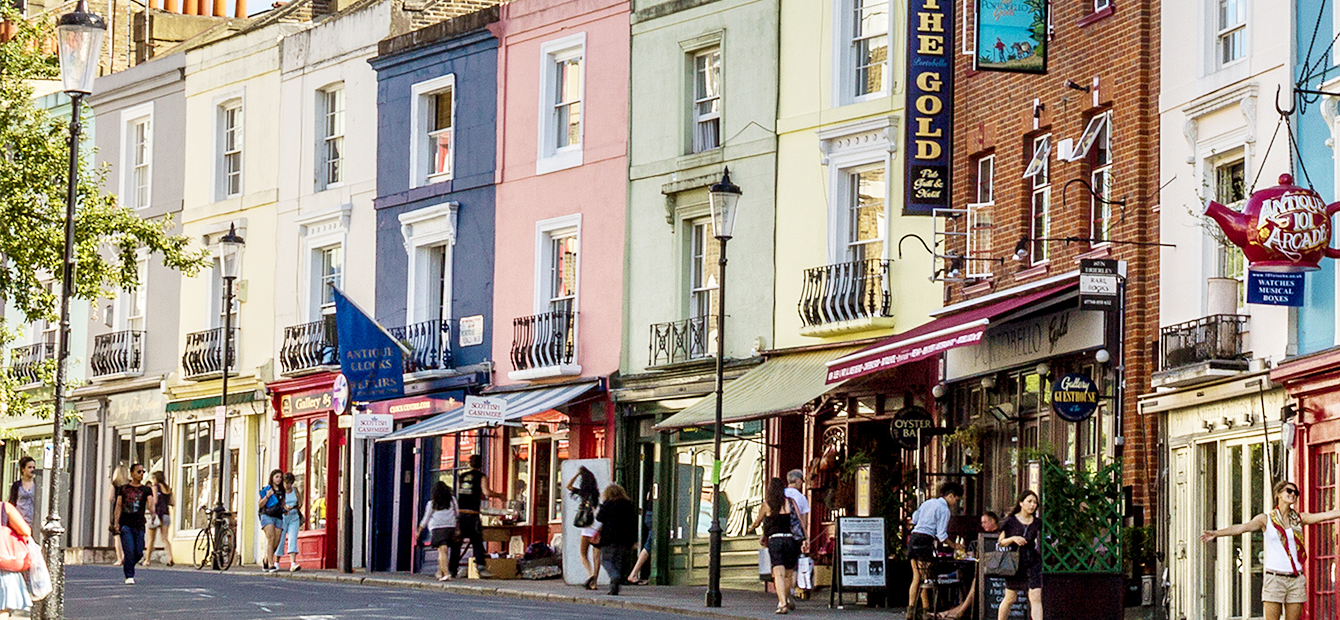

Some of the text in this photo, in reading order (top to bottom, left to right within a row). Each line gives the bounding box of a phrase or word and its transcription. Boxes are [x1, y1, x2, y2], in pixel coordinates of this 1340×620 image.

[915, 72, 943, 160] GOLD
[920, 168, 939, 179] Pub
[1293, 212, 1315, 231] 101
[1264, 224, 1327, 255] ARCADE
[346, 347, 394, 360] ANTIQUE
[350, 358, 393, 372] CLOCKS
[350, 377, 397, 390] REPAIRS
[1060, 376, 1090, 394] Gallery
[1054, 390, 1097, 403] GUESTHOUSE
[295, 396, 322, 411] Gallery
[471, 401, 500, 411] SCOTTISH
[468, 409, 502, 418] CASHMERE
[360, 419, 388, 427] SCOTTISH
[894, 419, 931, 429] OYSTER
[358, 426, 390, 434] CASHMERE
